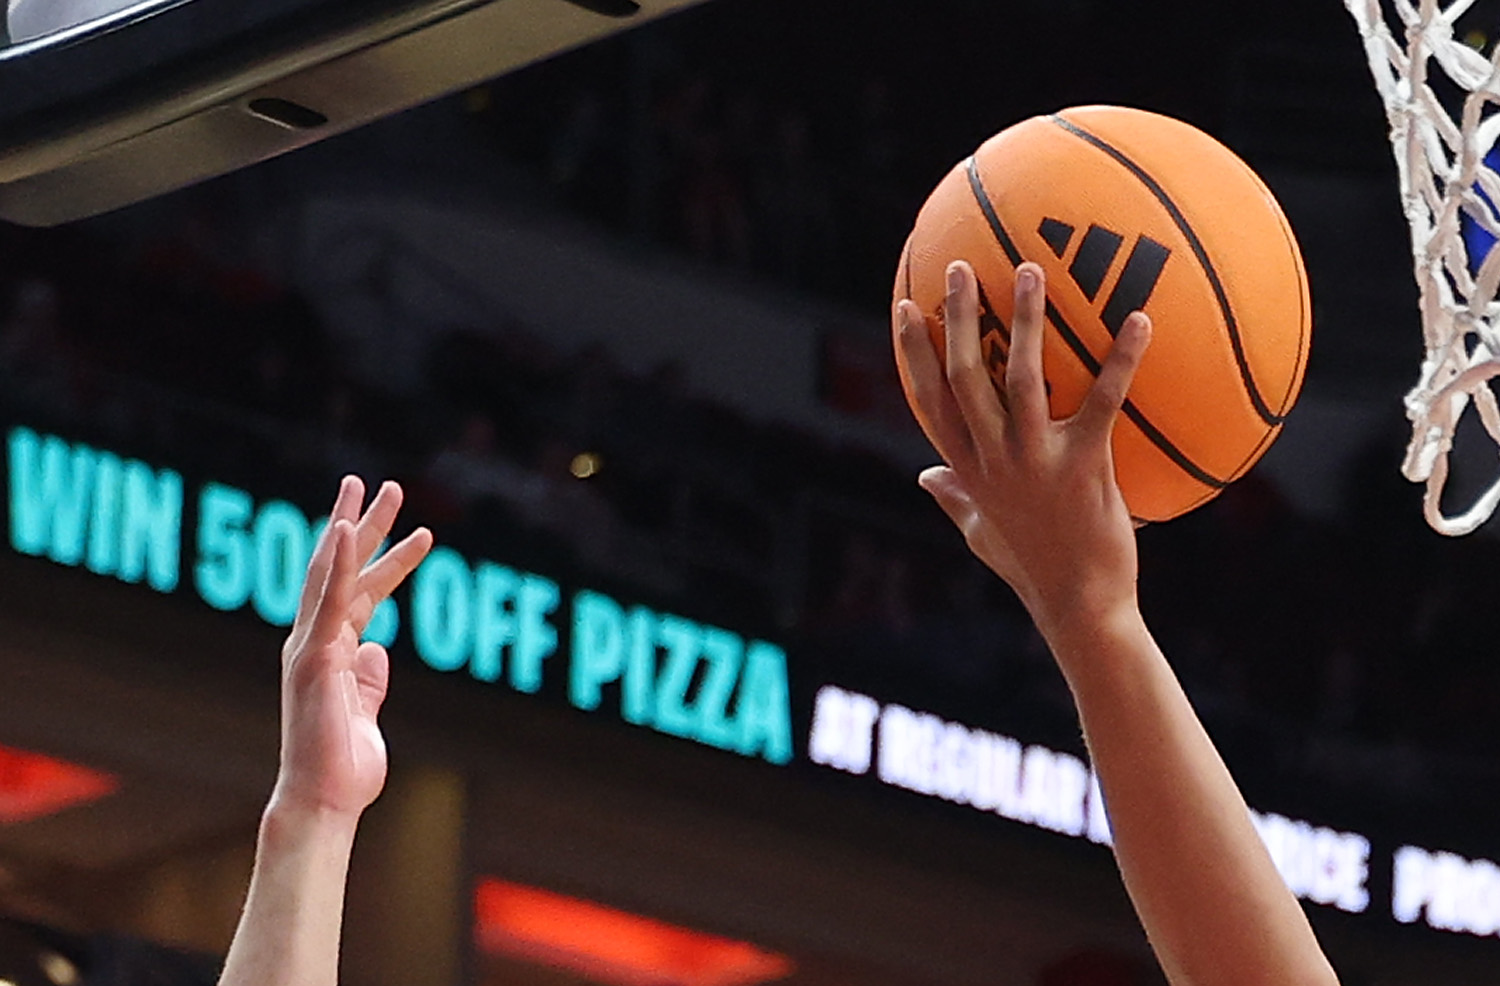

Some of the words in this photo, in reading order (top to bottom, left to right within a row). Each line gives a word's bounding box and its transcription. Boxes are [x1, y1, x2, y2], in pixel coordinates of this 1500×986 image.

[8, 427, 183, 592] WIN
[411, 547, 560, 693] OFF
[569, 590, 792, 765] PIZZA
[809, 686, 878, 774] AT
